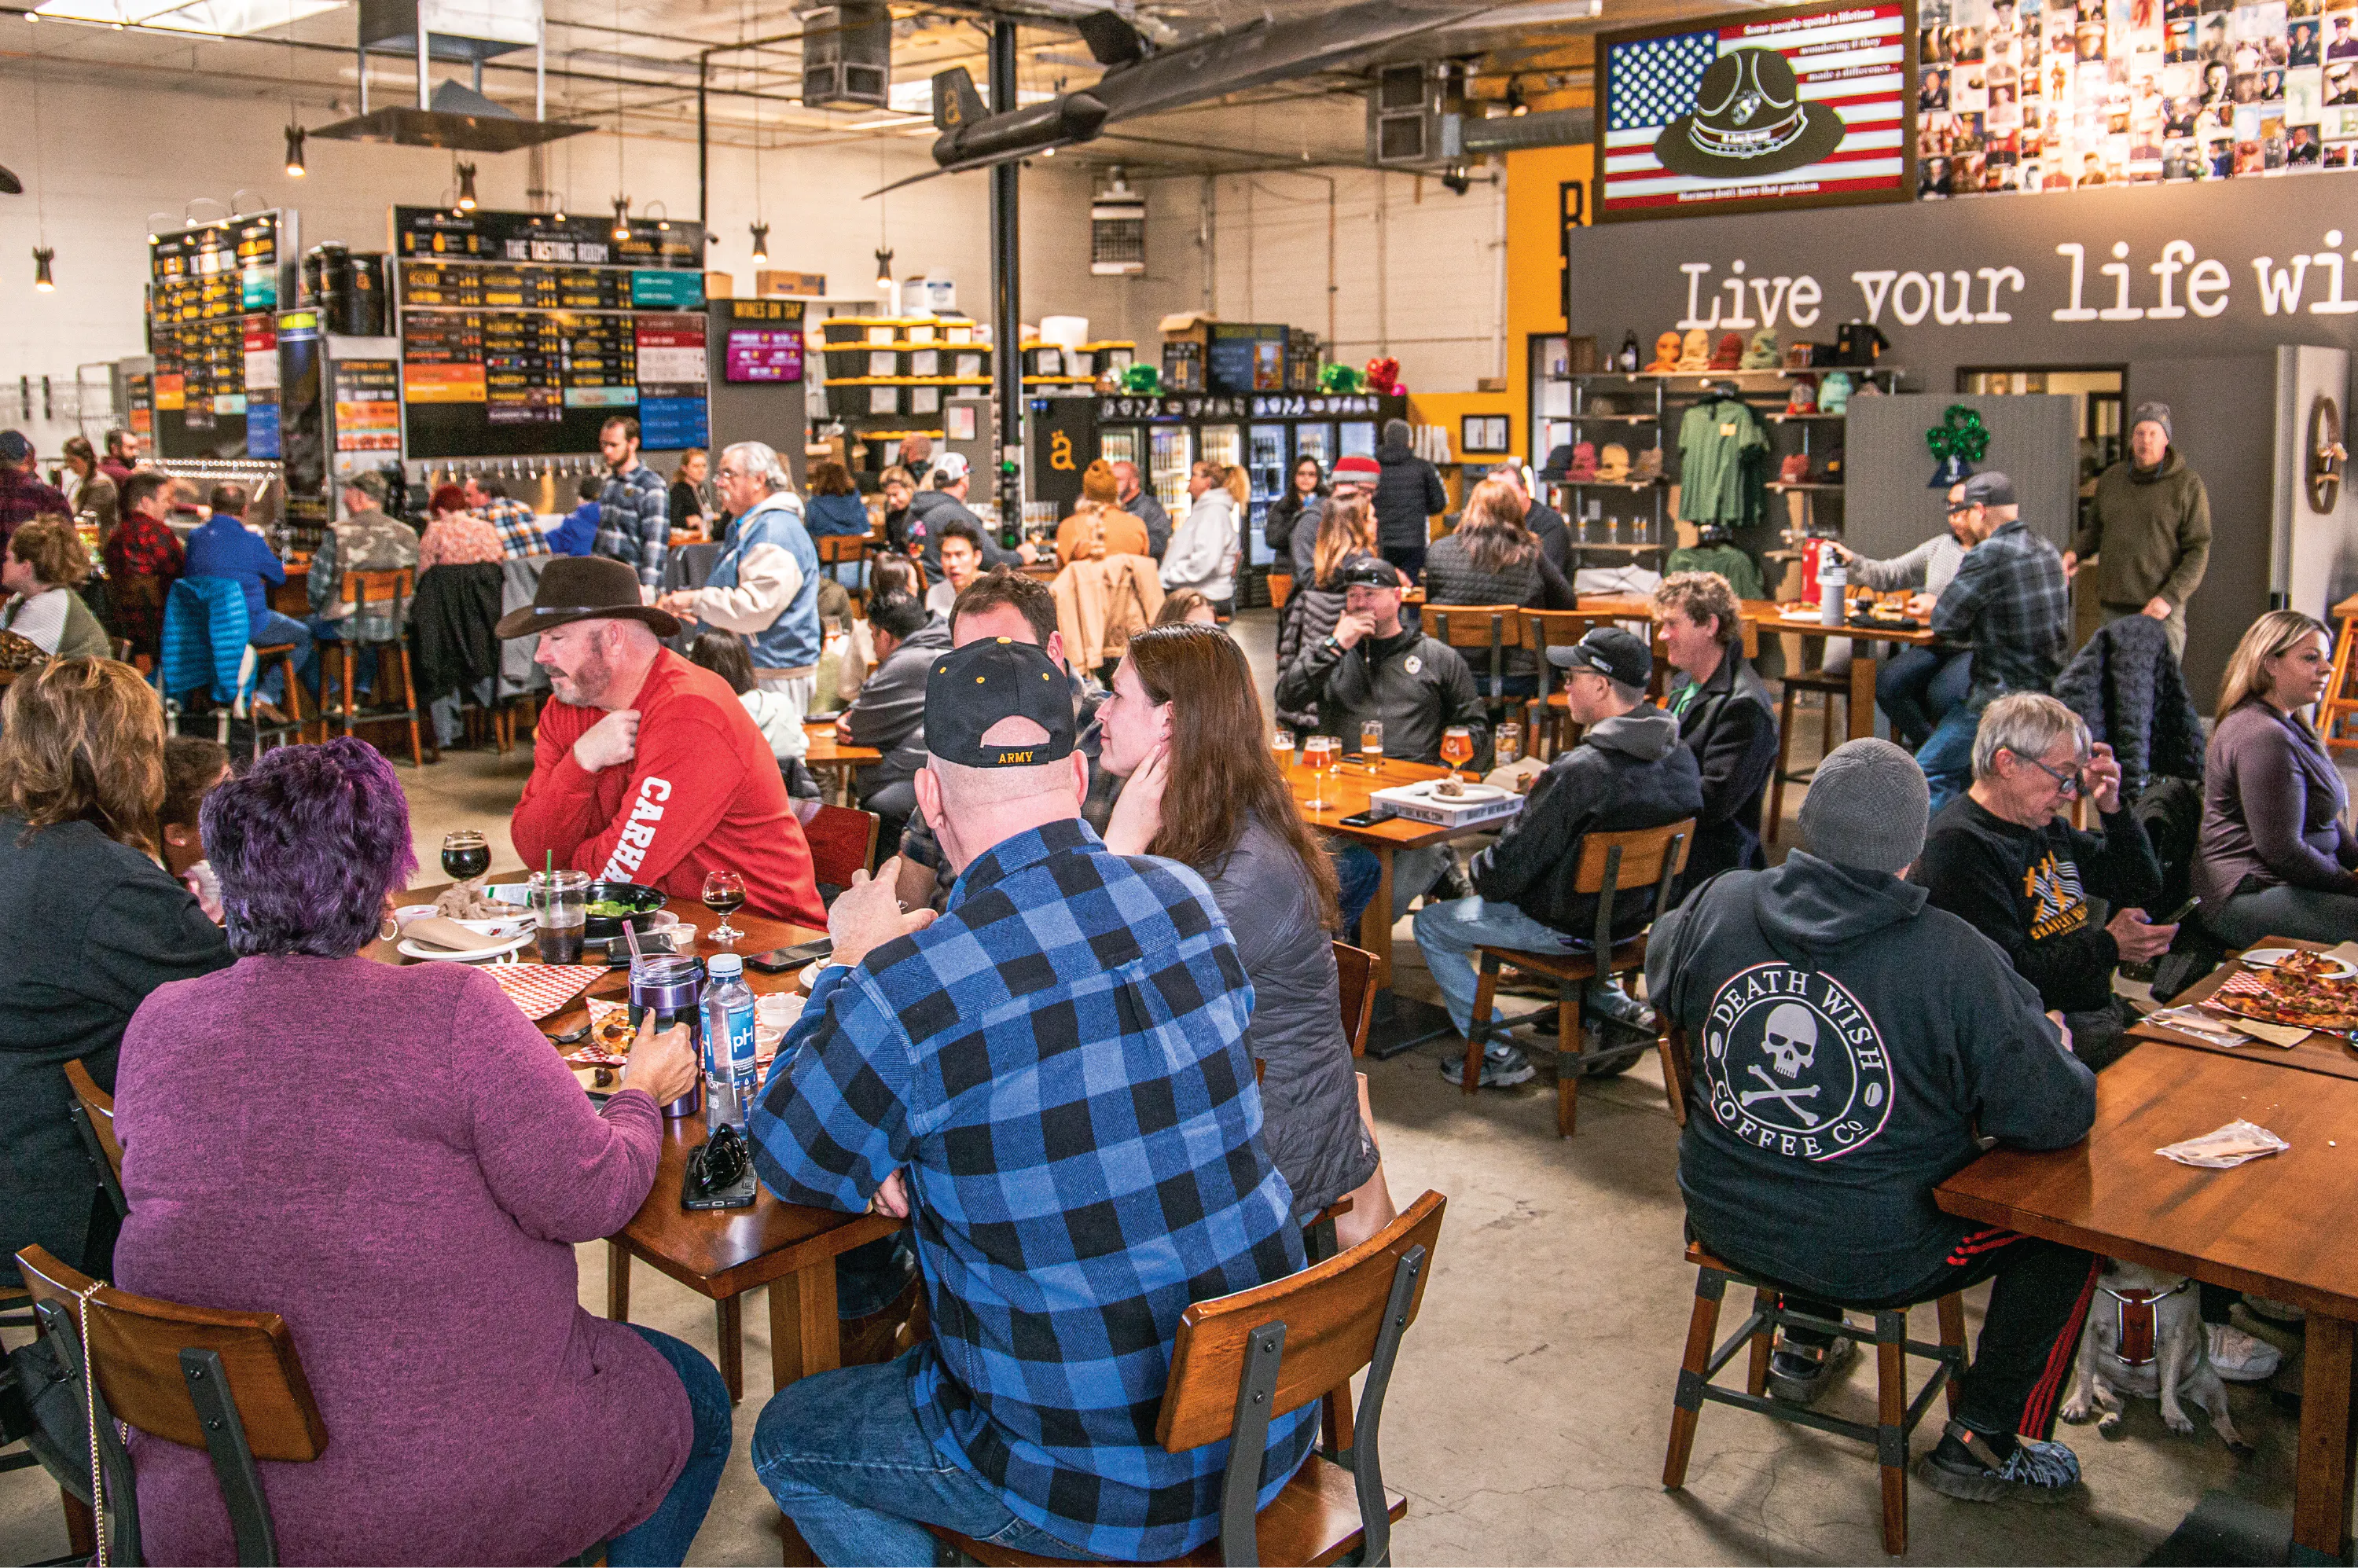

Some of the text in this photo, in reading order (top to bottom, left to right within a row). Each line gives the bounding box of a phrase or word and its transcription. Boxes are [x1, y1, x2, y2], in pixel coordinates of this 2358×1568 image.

[1743, 24, 1768, 36] Some
[1770, 18, 1802, 32] people
[1802, 13, 1831, 28] spend
[1838, 9, 1875, 24] lifetime
[1798, 36, 1882, 56] wondering if they
[1807, 70, 1834, 82] made
[1677, 191, 1714, 202] Marines
[1737, 185, 1760, 197] have
[1761, 183, 1779, 194] that
[1779, 182, 1820, 196] problem
[1676, 229, 2358, 330] Live your life wi
[997, 751, 1034, 765] ARMY
[599, 776, 672, 883] CARHA
[1713, 968, 1885, 1071] DEATH WISH
[733, 1025, 754, 1053] pH
[1715, 1080, 1823, 1157] COFFEE
